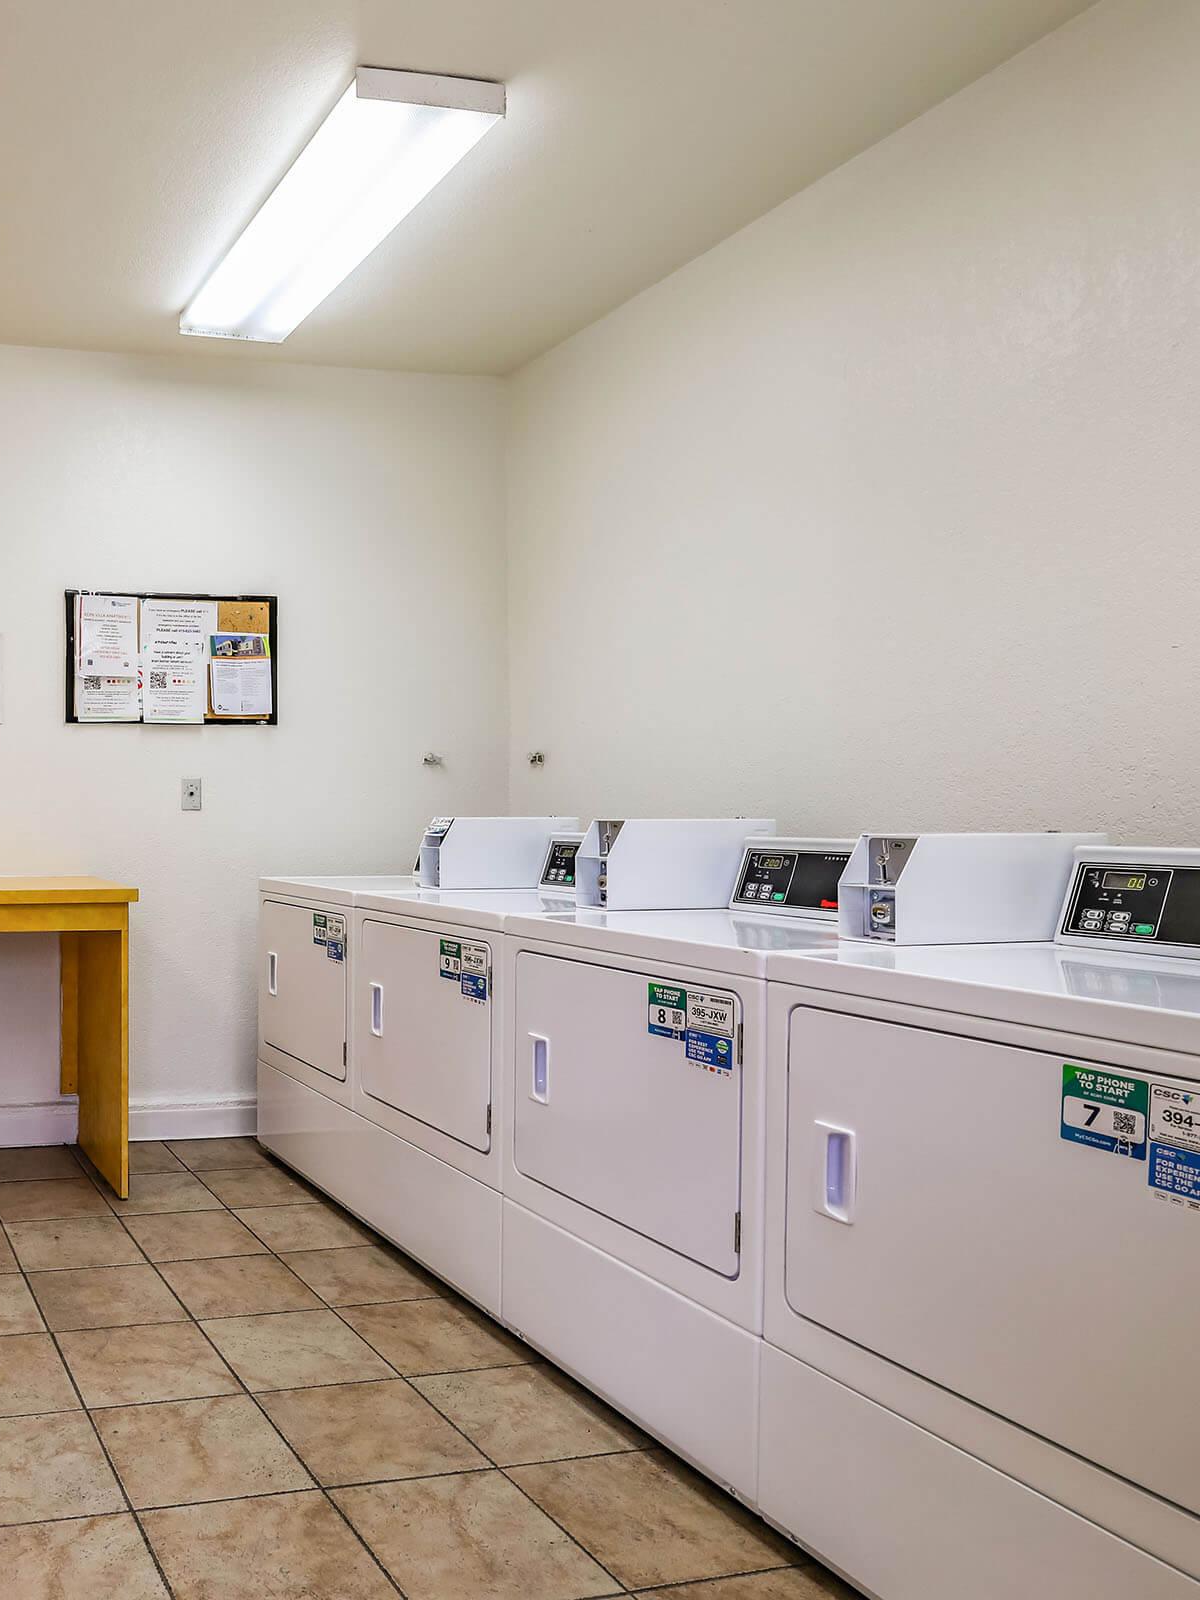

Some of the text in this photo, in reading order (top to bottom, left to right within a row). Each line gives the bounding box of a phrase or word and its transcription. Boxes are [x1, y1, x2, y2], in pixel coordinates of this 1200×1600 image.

[445, 958, 450, 969] 9
[658, 1009, 666, 1024] 8
[691, 1008, 727, 1021] 395-JXW
[1075, 1071, 1135, 1091] TAP PHONE
[1079, 1080, 1130, 1097] TO START
[1154, 1089, 1181, 1100] CSC
[1083, 1104, 1100, 1126] 7
[1156, 1148, 1176, 1157] CSC
[1156, 1159, 1200, 1175] FOR BEST
[1155, 1172, 1193, 1187] USE THE
[1155, 1180, 1173, 1189] CSC
[1174, 1184, 1188, 1193] GO
